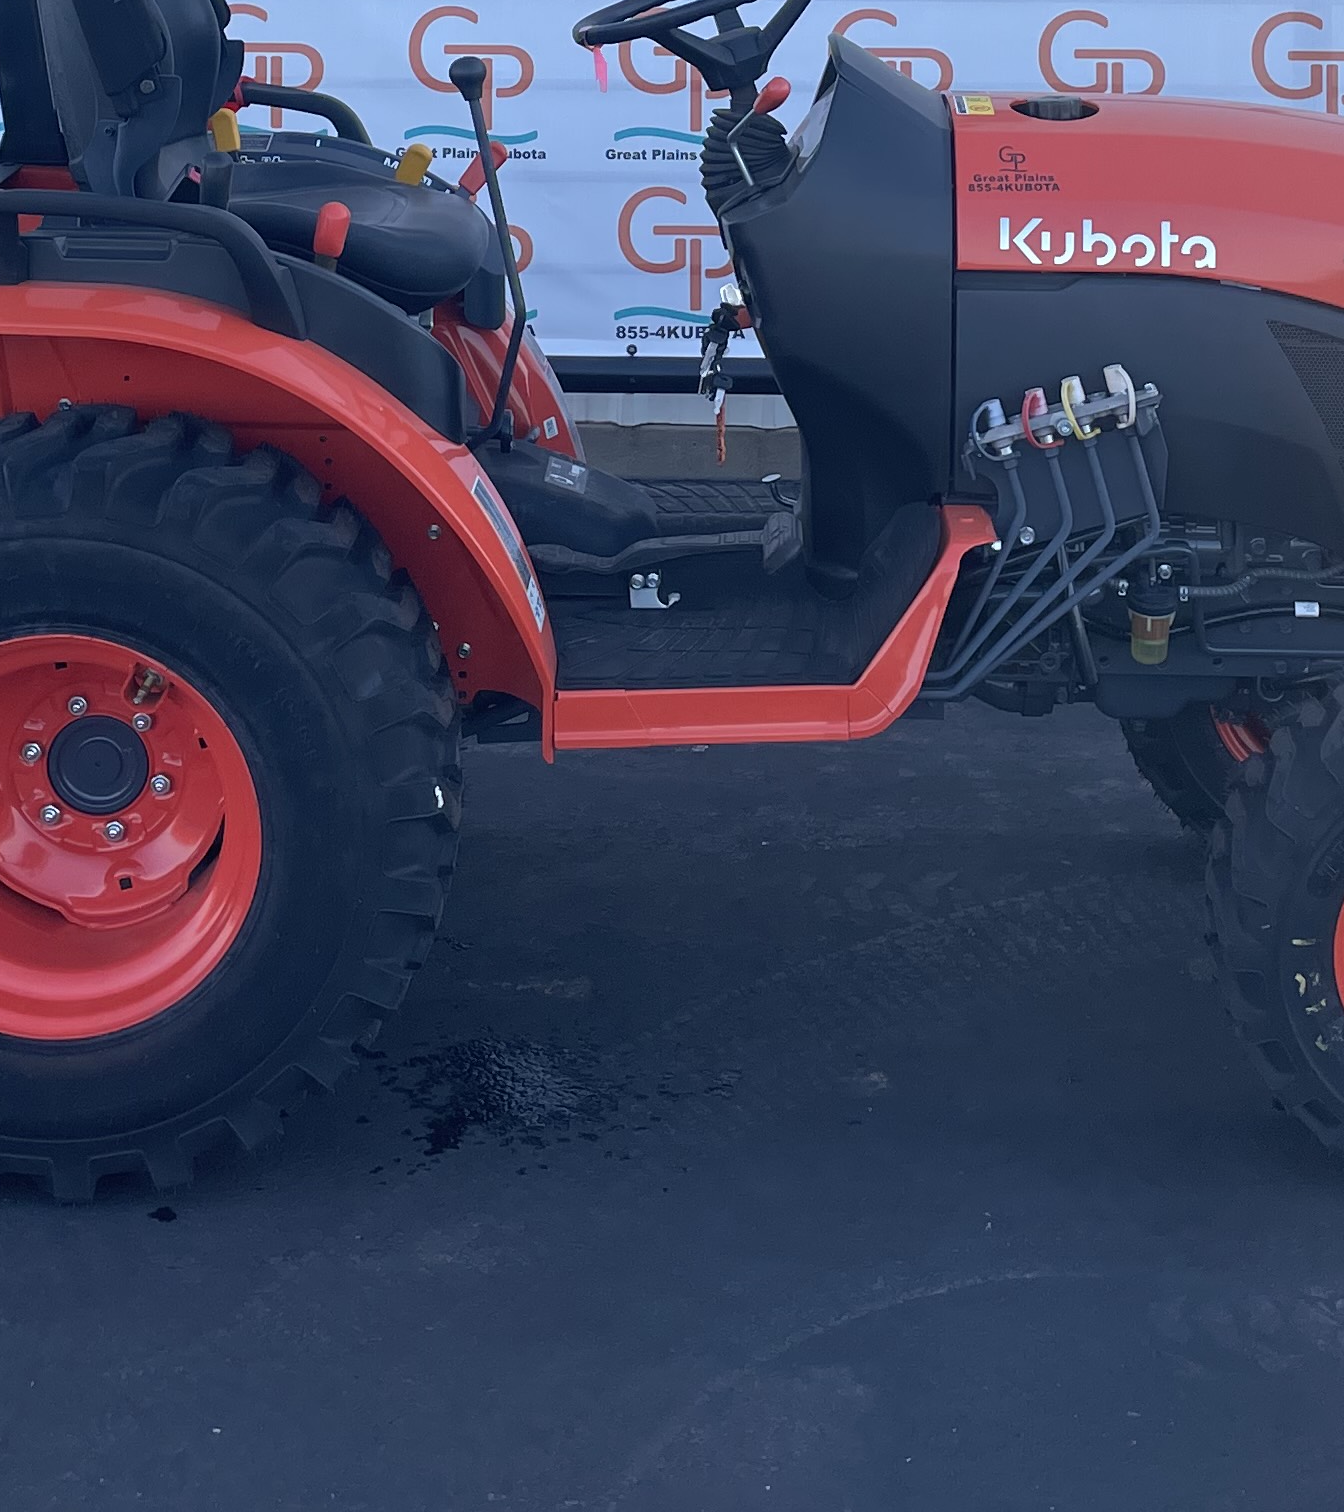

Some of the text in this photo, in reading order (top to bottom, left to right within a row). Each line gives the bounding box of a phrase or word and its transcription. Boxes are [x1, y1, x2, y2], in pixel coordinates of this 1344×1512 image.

[507, 148, 547, 160] ubota
[606, 149, 698, 161] Great Plains
[973, 173, 1055, 183] Great Plains
[967, 183, 1061, 193] 855-4KUBOTA
[999, 216, 1217, 269] Kubota
